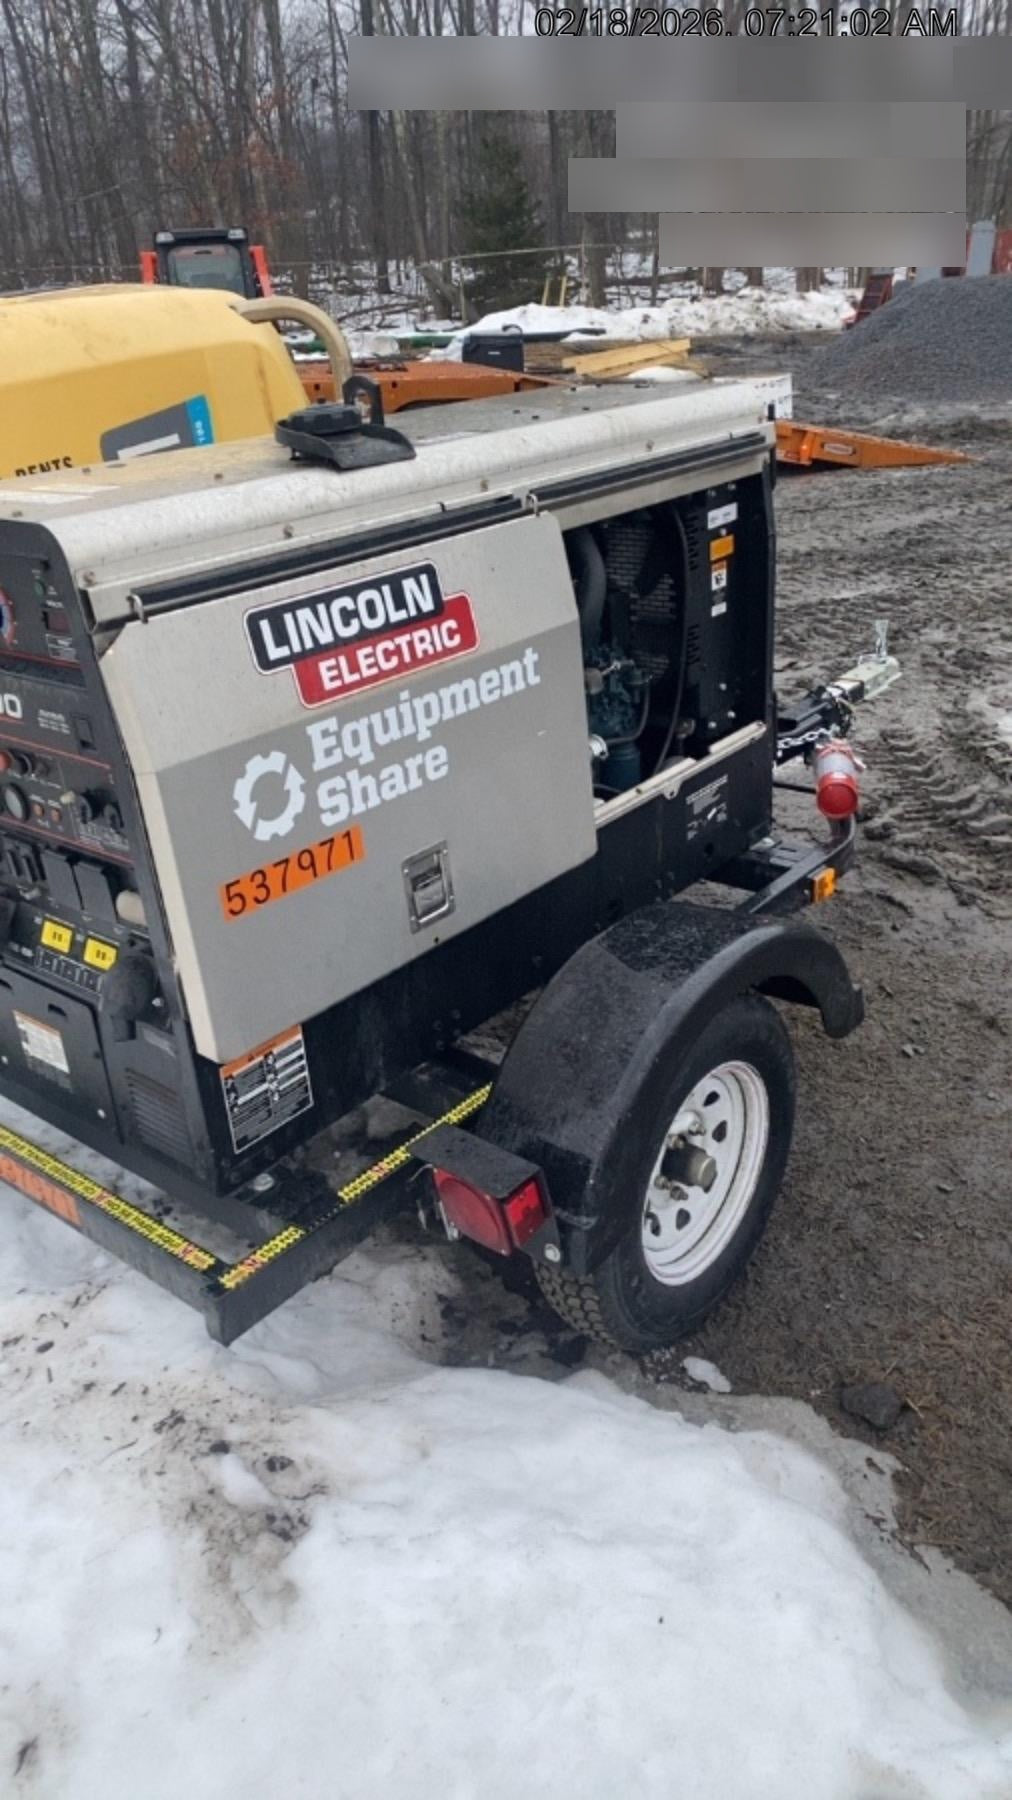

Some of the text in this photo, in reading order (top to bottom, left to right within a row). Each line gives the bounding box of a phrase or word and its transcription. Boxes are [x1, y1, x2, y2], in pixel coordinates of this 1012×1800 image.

[258, 573, 435, 661] LINCOLN
[317, 619, 462, 691] ELECTRIC
[0, 692, 23, 719] 0
[305, 647, 541, 772] Equipment
[315, 744, 449, 827] Share
[224, 829, 356, 917] 537971
